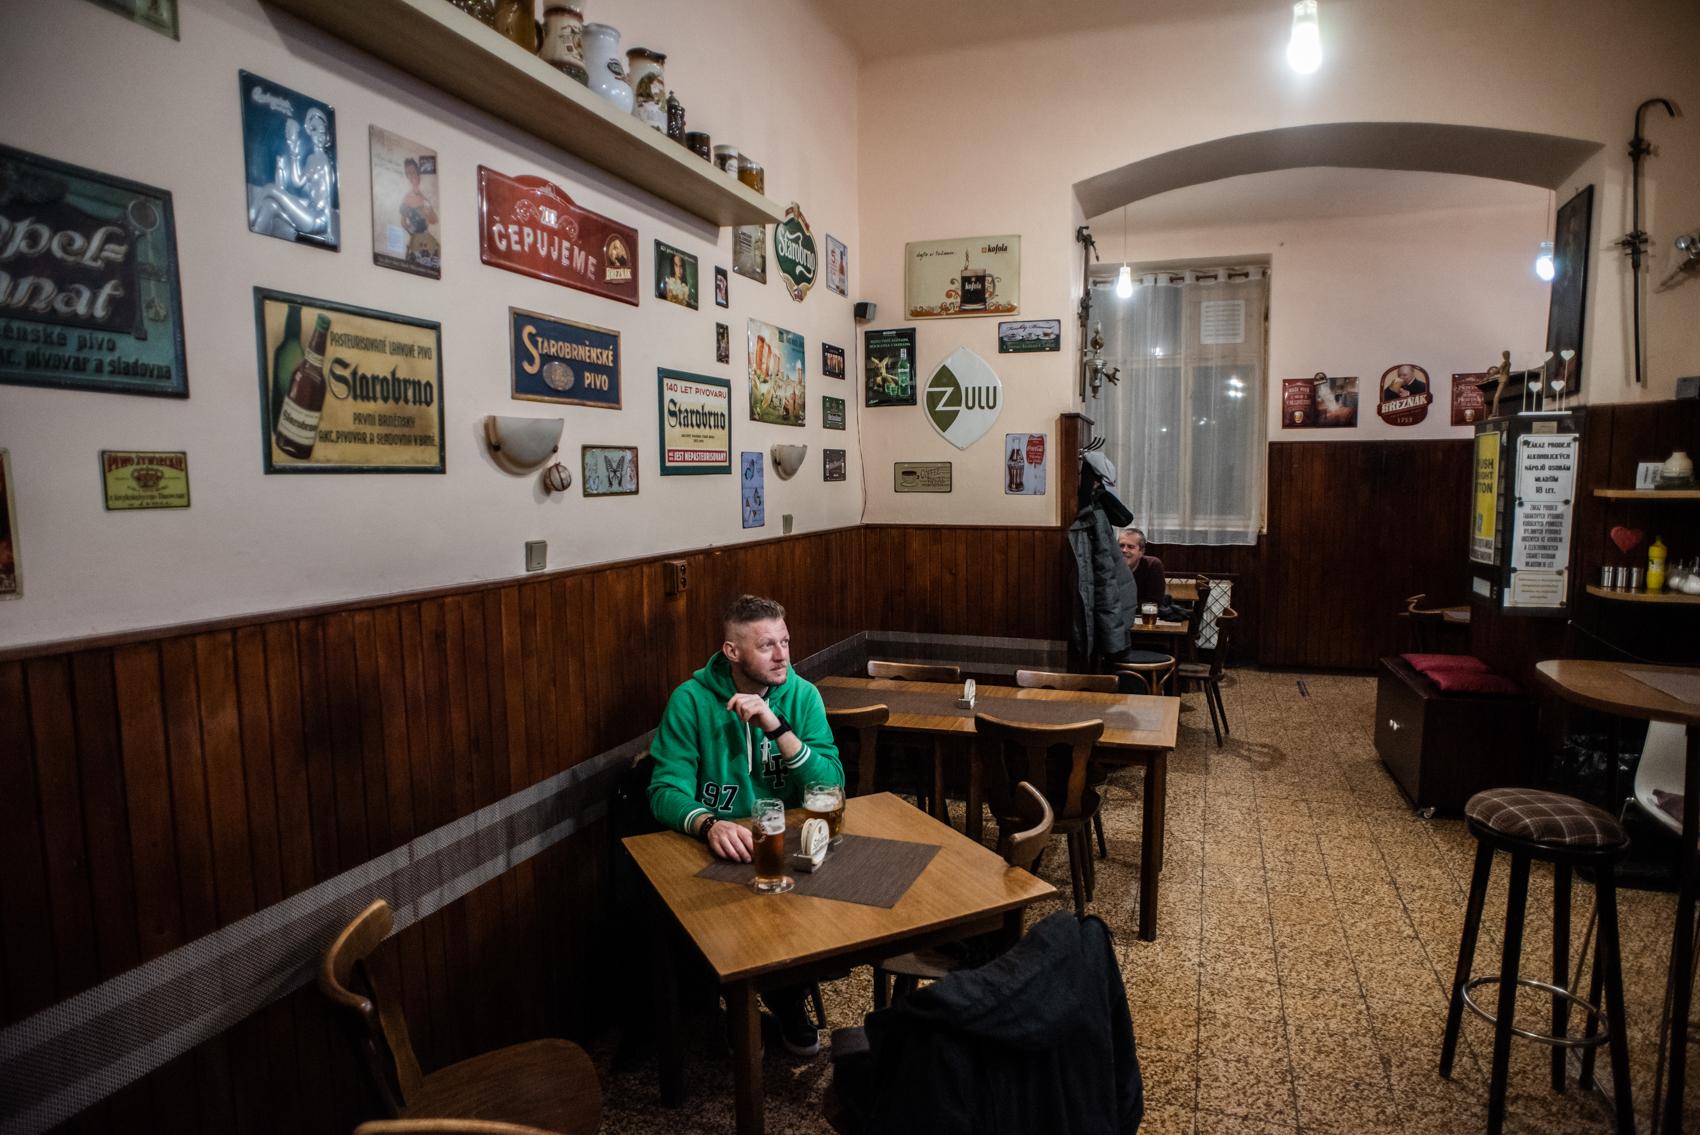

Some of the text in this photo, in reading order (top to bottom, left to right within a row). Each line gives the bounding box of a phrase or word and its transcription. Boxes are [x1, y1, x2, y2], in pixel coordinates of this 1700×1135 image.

[492, 215, 597, 280] ČEPUJEME
[778, 225, 816, 278] Starobrno
[987, 243, 1008, 255] kofola
[26, 348, 89, 372] pivovar
[95, 357, 104, 374] a
[328, 357, 434, 407] Starobrno
[584, 371, 609, 391] PIVO
[666, 382, 727, 399] 140 LET PIVOVARU
[926, 386, 998, 411] ZULU
[667, 398, 726, 431] Starobrno
[702, 781, 739, 813] 97
